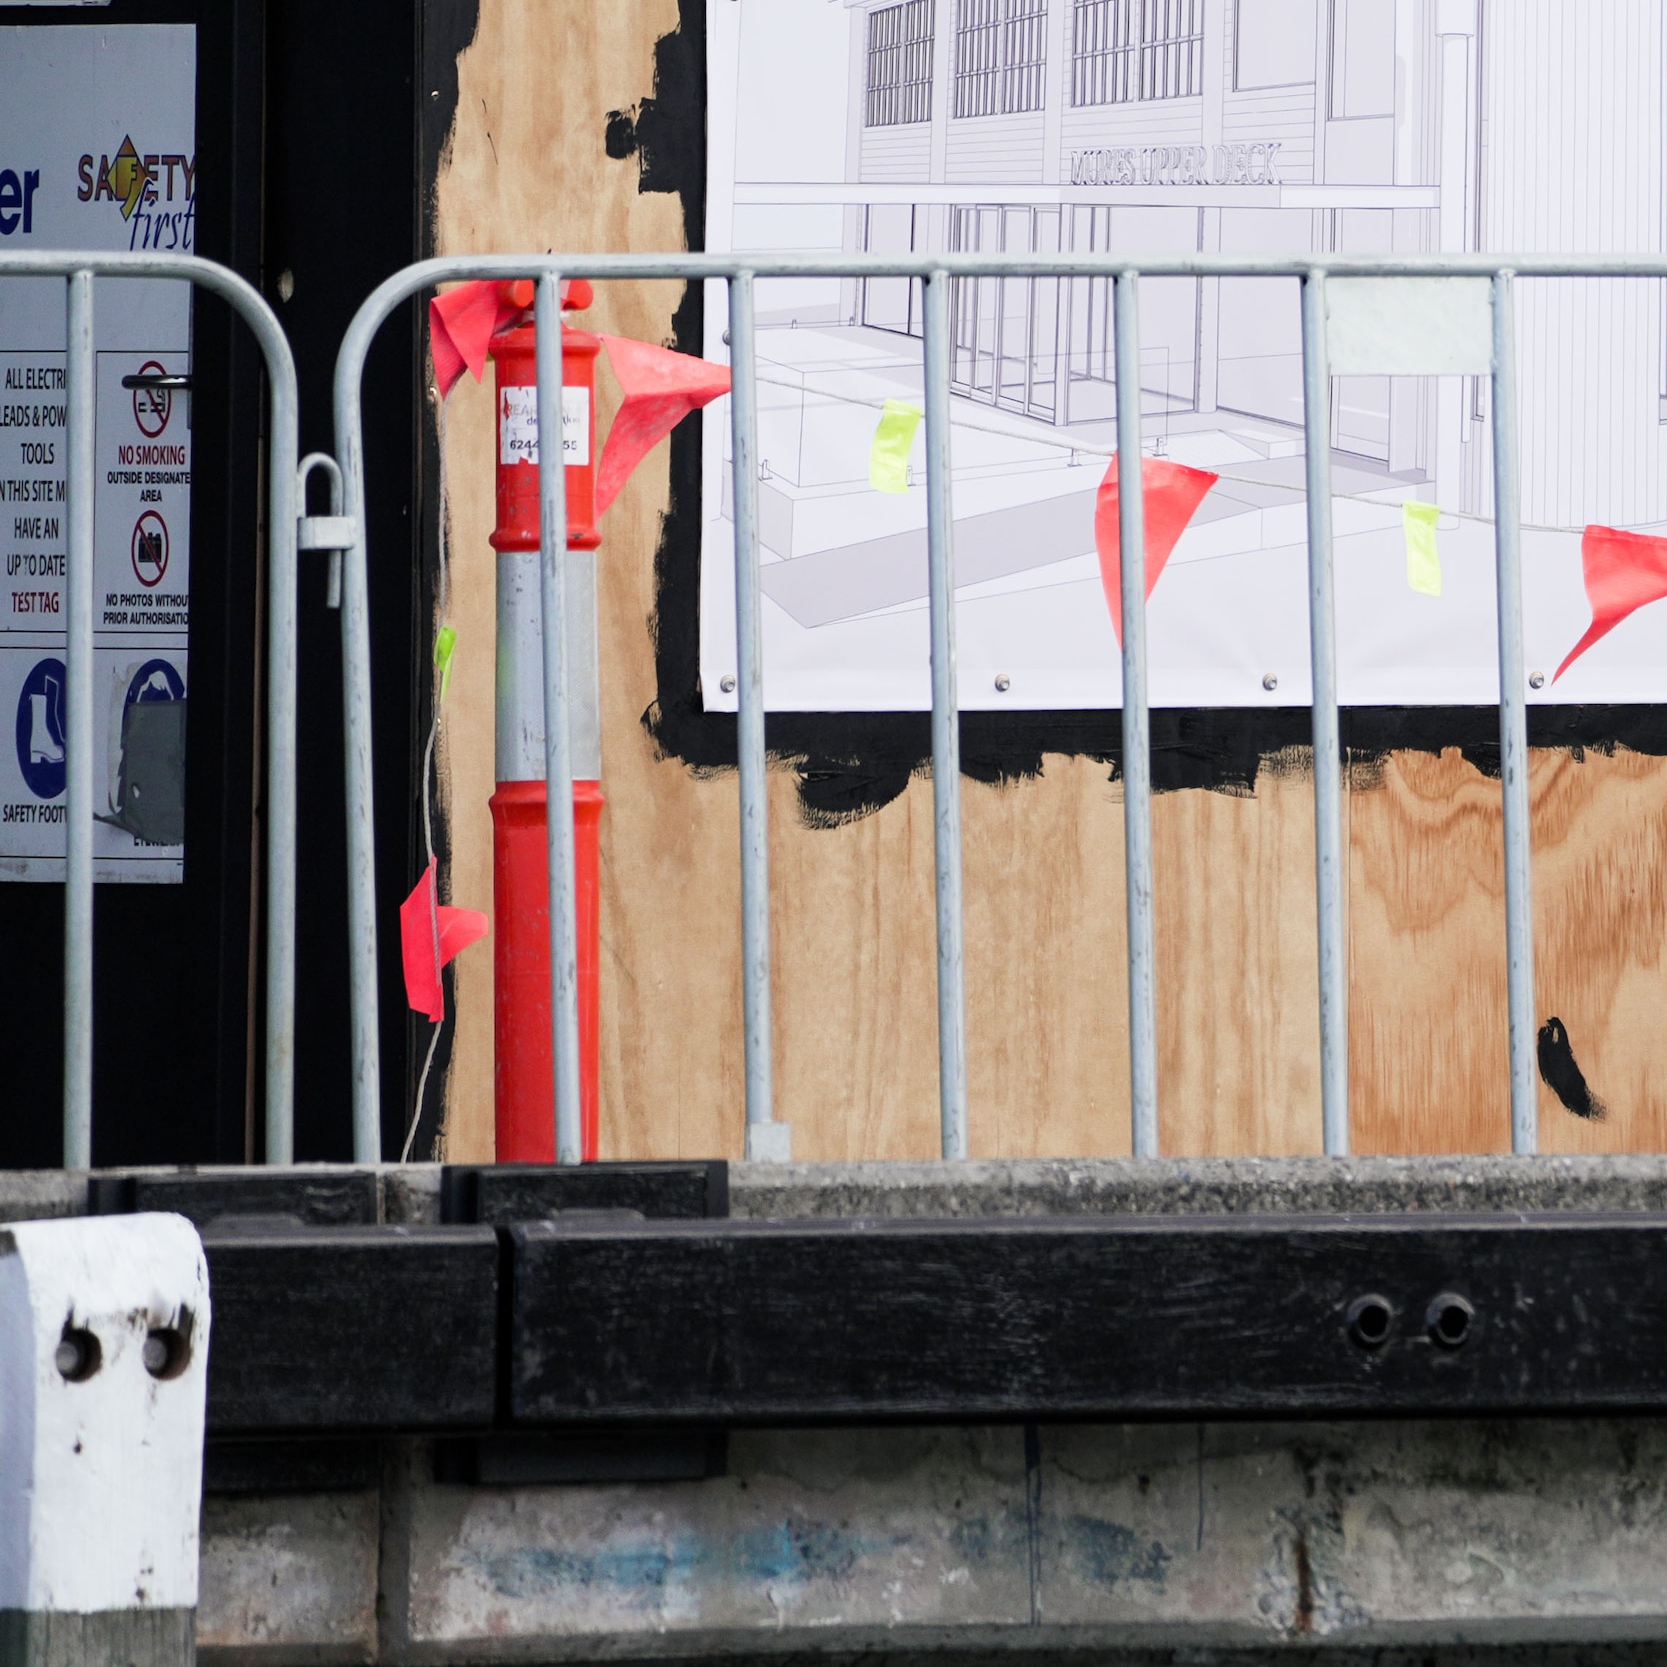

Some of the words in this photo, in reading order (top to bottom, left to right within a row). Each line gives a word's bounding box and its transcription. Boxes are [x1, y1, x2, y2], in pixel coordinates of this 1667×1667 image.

[1071, 148, 1137, 185] MURES
[1139, 146, 1208, 185] UPPER
[1213, 143, 1282, 184] DECK
[77, 154, 196, 202] SAFETY
[130, 177, 195, 251] first
[5, 368, 23, 389] ALL
[26, 368, 66, 390] ELECTRI
[32, 405, 40, 427] &
[42, 405, 67, 427] POW
[21, 443, 54, 465] TOOLS
[118, 445, 134, 465] NO
[136, 445, 185, 465] SMOKING
[107, 471, 143, 484] OUTSIDE
[7, 480, 29, 502] THIS
[32, 480, 53, 502] SITE
[140, 490, 162, 502] AREA
[14, 518, 41, 539] HAVE
[44, 518, 59, 539] AN
[7, 554, 21, 576] UP
[23, 554, 37, 576] TO
[39, 554, 65, 576] DATE
[12, 592, 36, 613] TEST
[38, 592, 59, 613] TAG
[106, 594, 118, 607] NO
[120, 594, 153, 607] PHOTOS
[103, 612, 128, 624] PRIOR
[3, 804, 37, 823] SAFETY
[39, 805, 67, 824] FOOT
